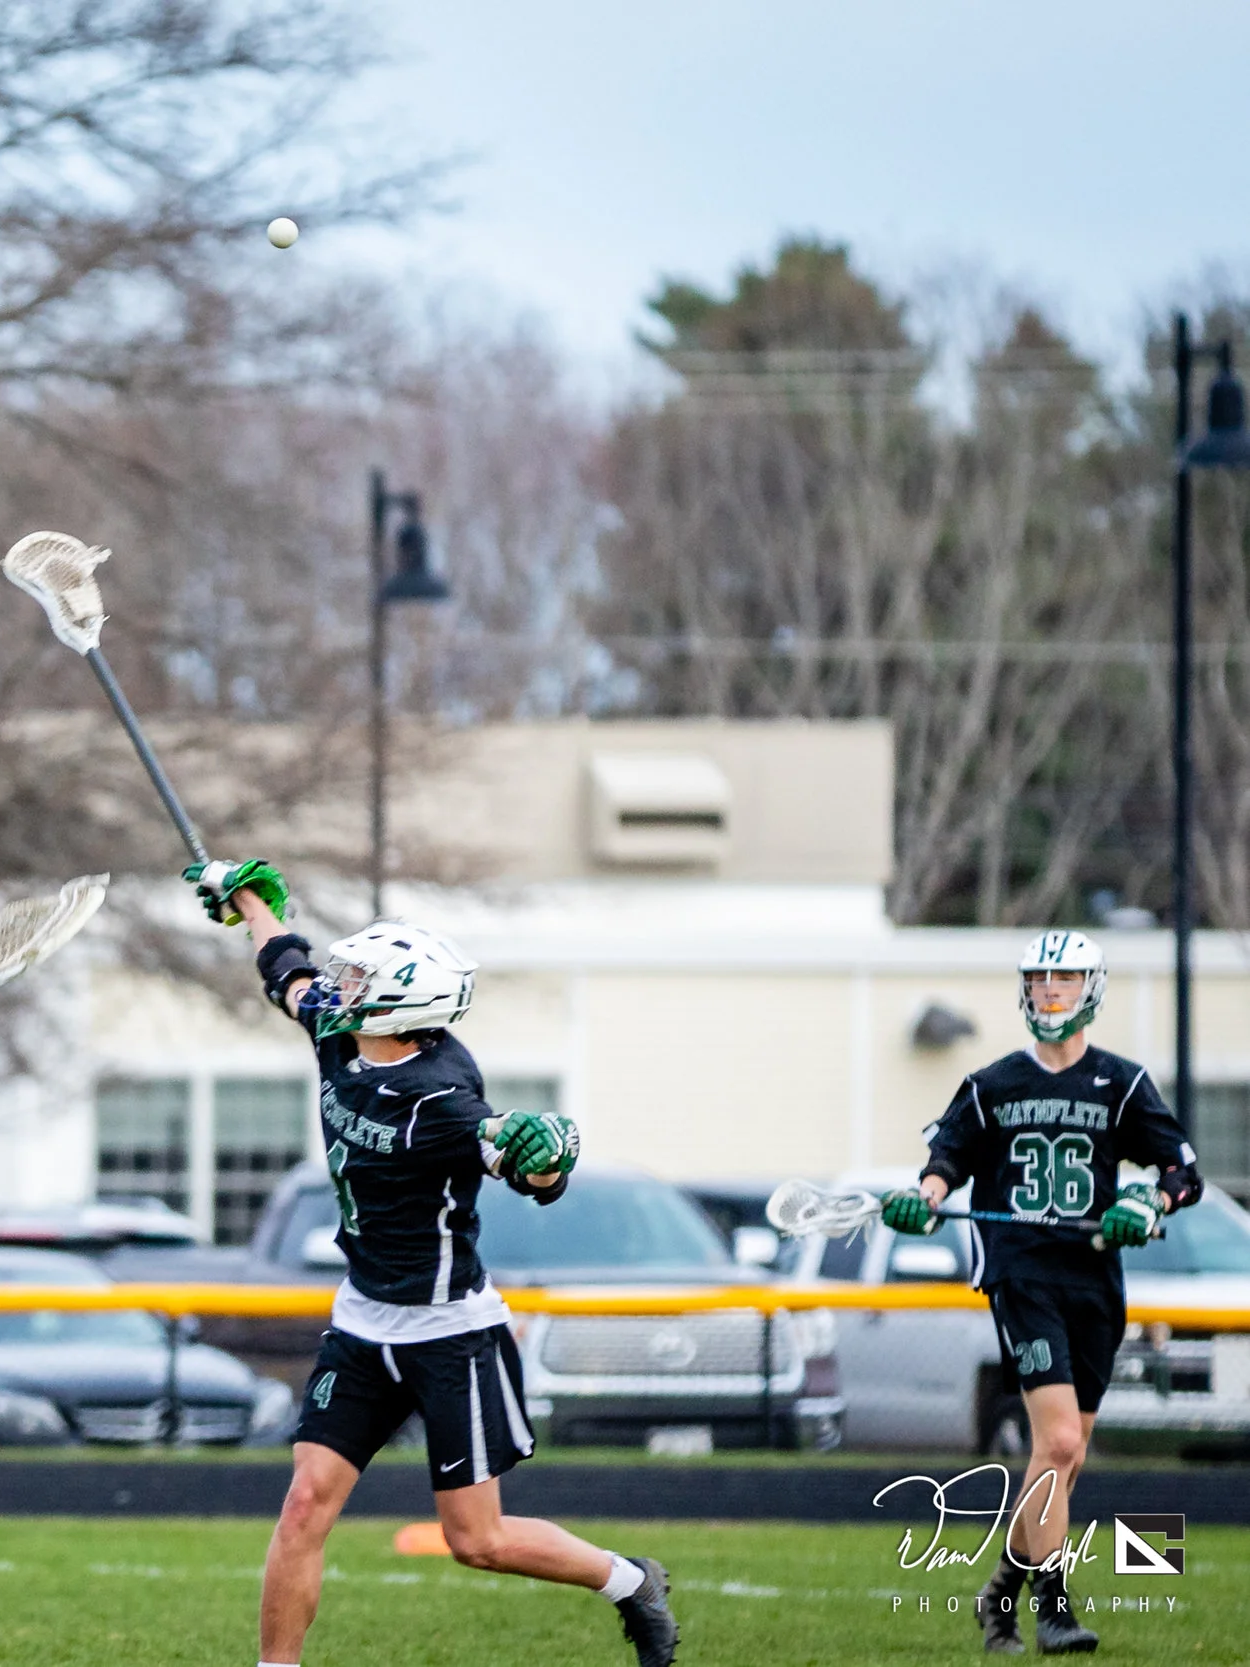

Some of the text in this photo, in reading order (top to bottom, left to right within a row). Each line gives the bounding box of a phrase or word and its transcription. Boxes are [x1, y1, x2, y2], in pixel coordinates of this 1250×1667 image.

[393, 962, 419, 987] 4
[1010, 1131, 1095, 1217] 36
[312, 1370, 338, 1409] 4
